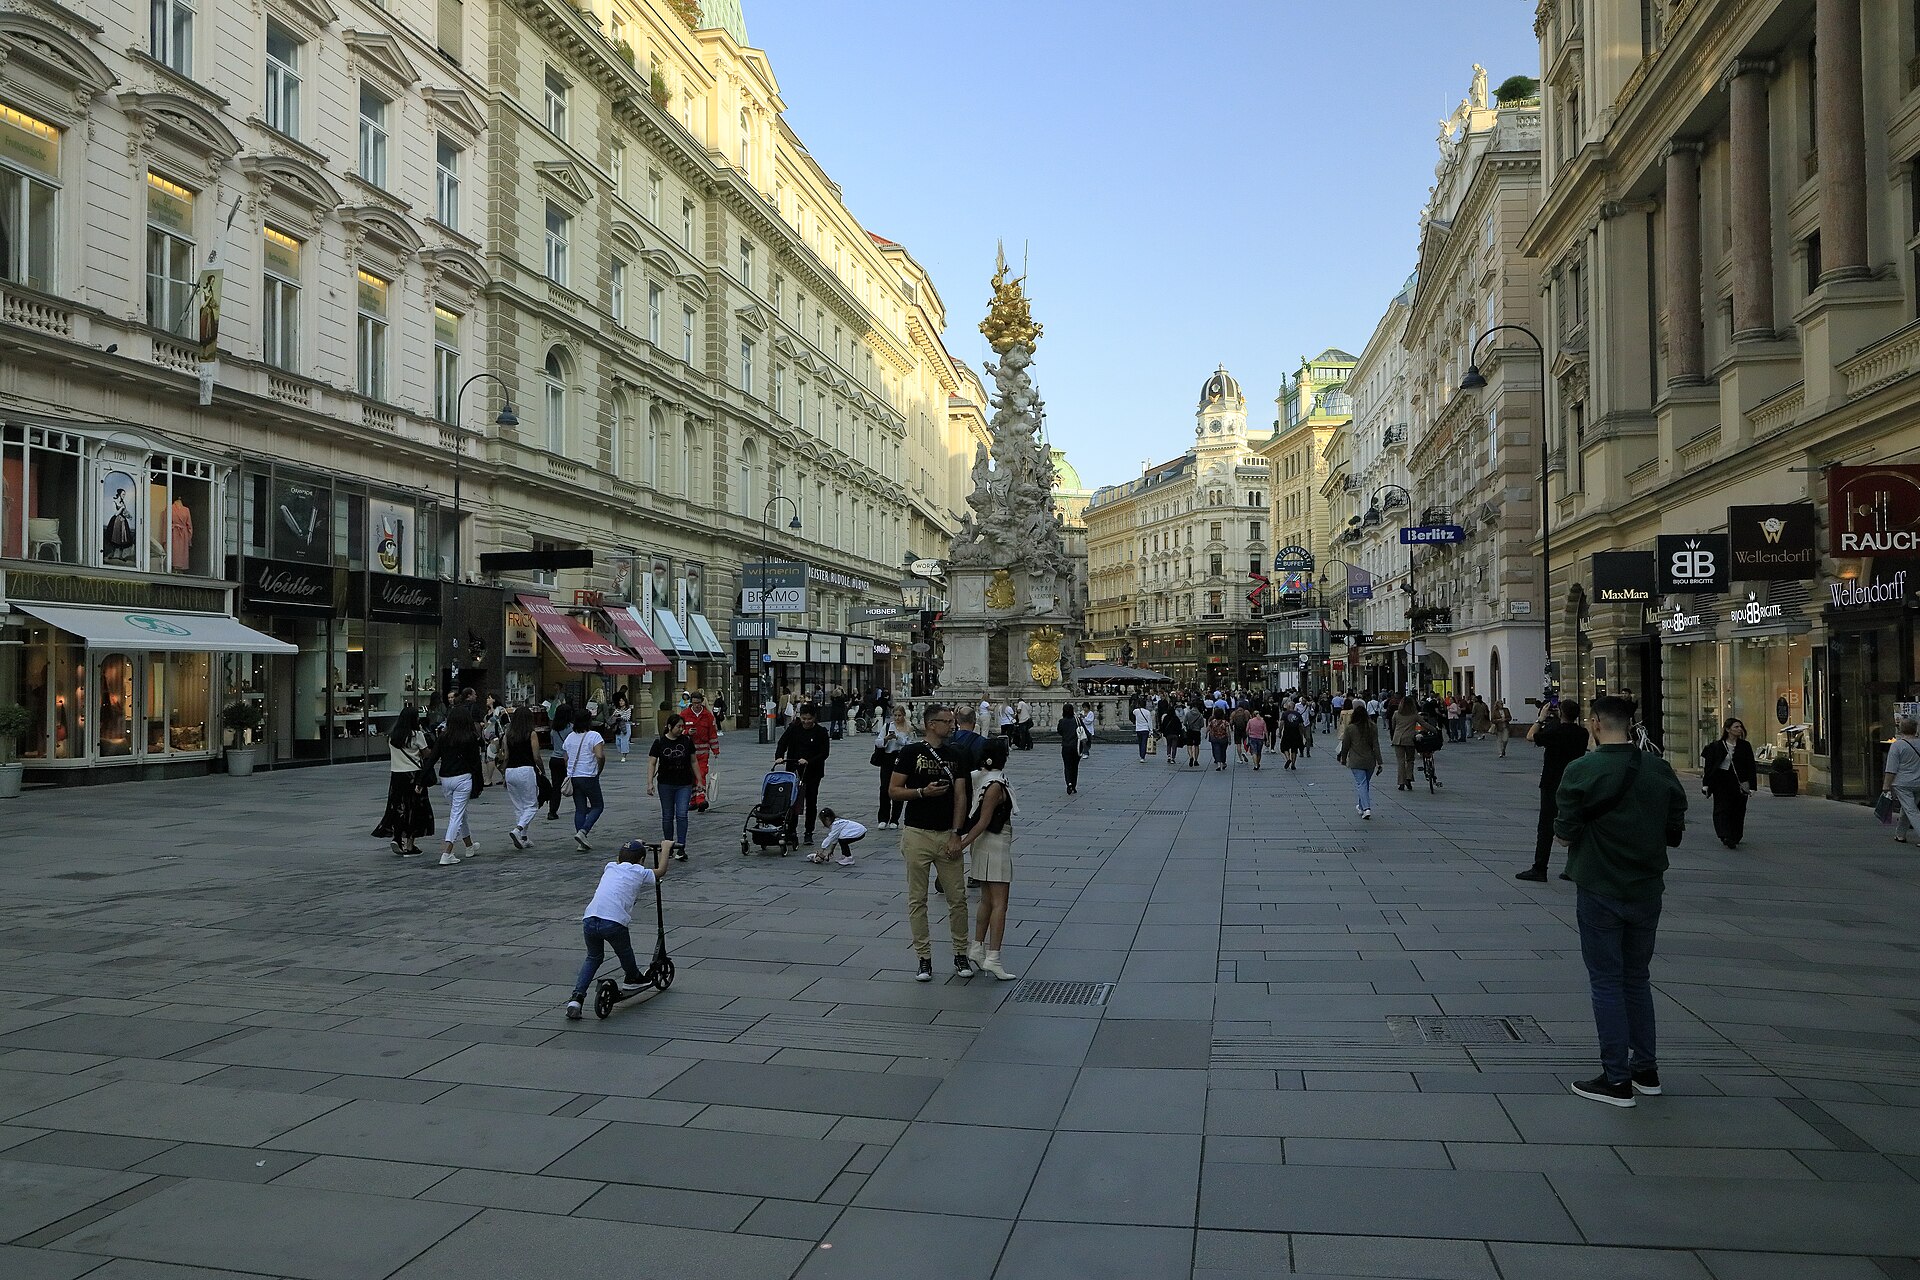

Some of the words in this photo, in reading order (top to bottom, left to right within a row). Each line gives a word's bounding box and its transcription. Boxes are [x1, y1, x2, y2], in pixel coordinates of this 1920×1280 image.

[114, 450, 127, 461] 1720
[1407, 528, 1455, 541] Berlitz
[1735, 548, 1813, 563] Wellendorff
[11, 572, 41, 597] ZUR
[259, 565, 323, 596] Weidler
[382, 579, 432, 607] Weidler
[1601, 589, 1649, 600] MaxMara
[1829, 570, 1907, 608] Wellendorff
[747, 590, 800, 603] BRAMO
[508, 612, 535, 629] FRICK
[516, 630, 526, 639] Die
[543, 623, 571, 635] BOOKS
[582, 643, 628, 656] FRICK
